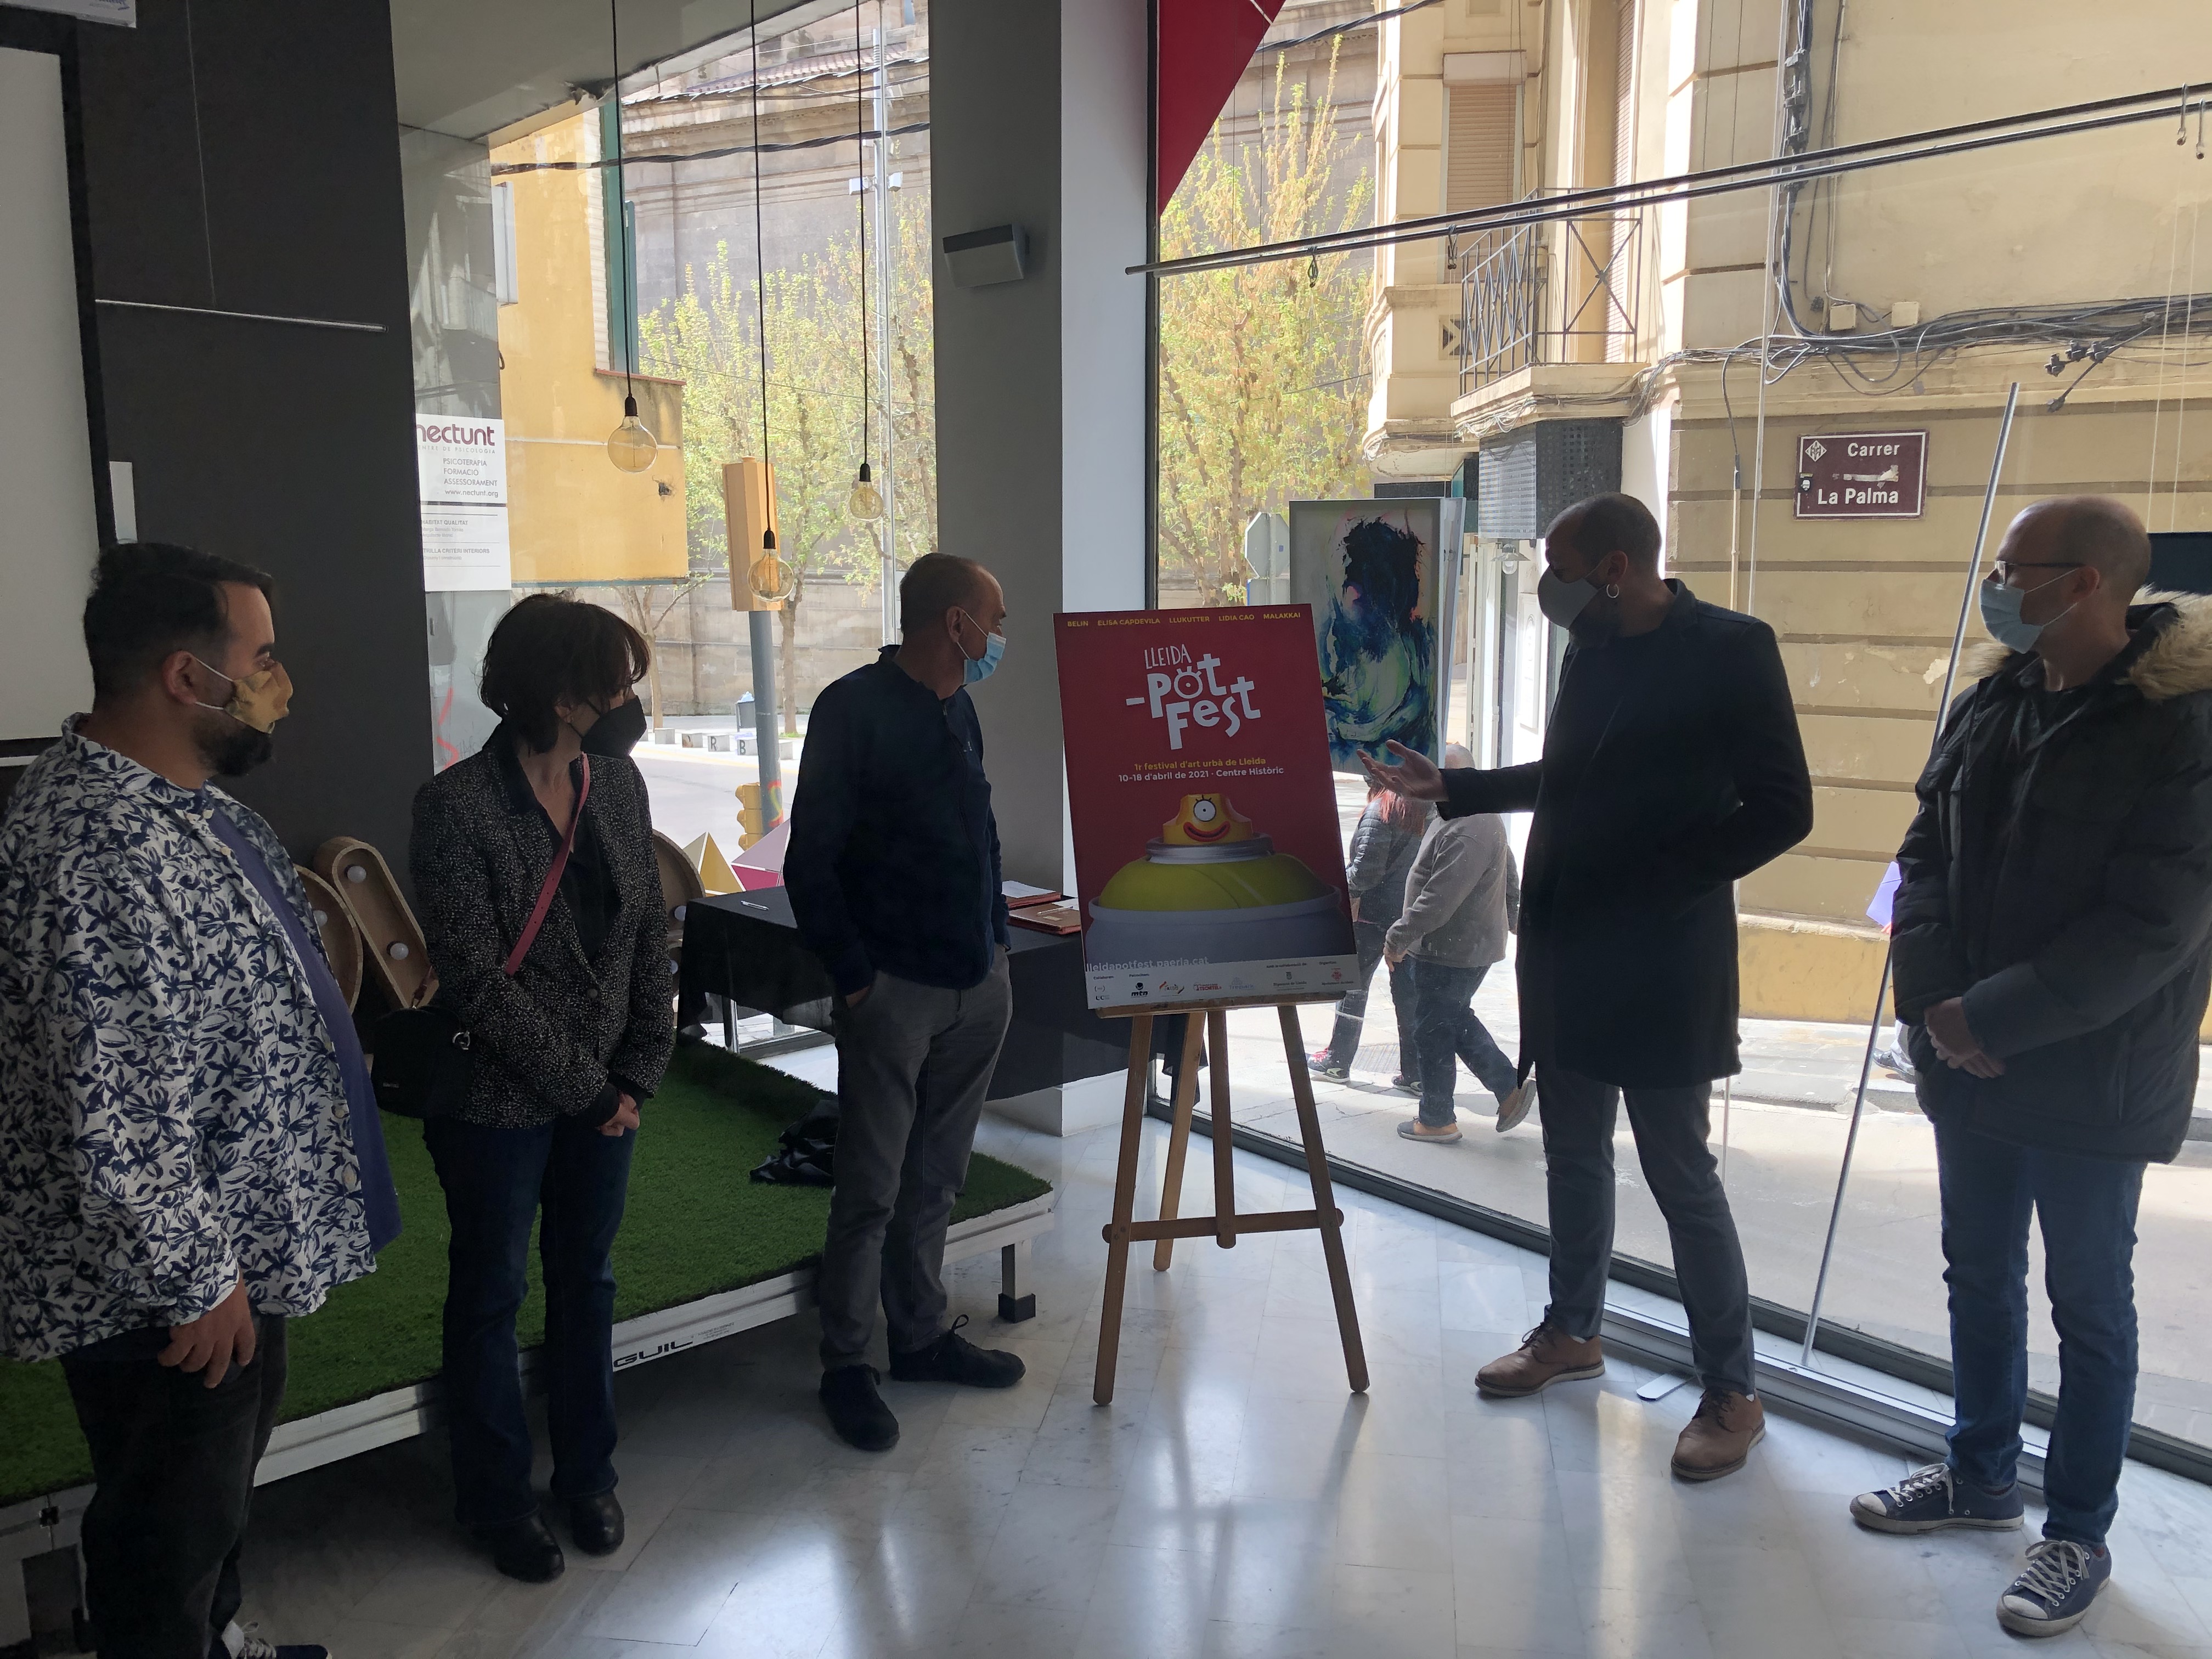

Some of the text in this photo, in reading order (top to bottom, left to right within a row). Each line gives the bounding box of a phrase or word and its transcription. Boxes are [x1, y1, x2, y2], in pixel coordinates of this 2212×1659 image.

[1848, 442, 1900, 457] Carrer
[443, 458, 487, 466] PSICOTERAPIA
[444, 478, 498, 487] ASSESSORAMENT
[445, 489, 499, 498] www.nectunt.org
[1818, 487, 1899, 505] La Palma
[1144, 644, 1192, 669] LLEIDA
[710, 736, 717, 751] R
[740, 740, 746, 755] B
[1144, 761, 1177, 770] festival
[1203, 759, 1223, 767] urbà
[1226, 758, 1237, 766] de
[1239, 758, 1266, 766] Lleida
[1118, 766, 1284, 782] 10-18 d'abril de 2021 Centre Històric
[613, 1341, 693, 1368] GUIL
